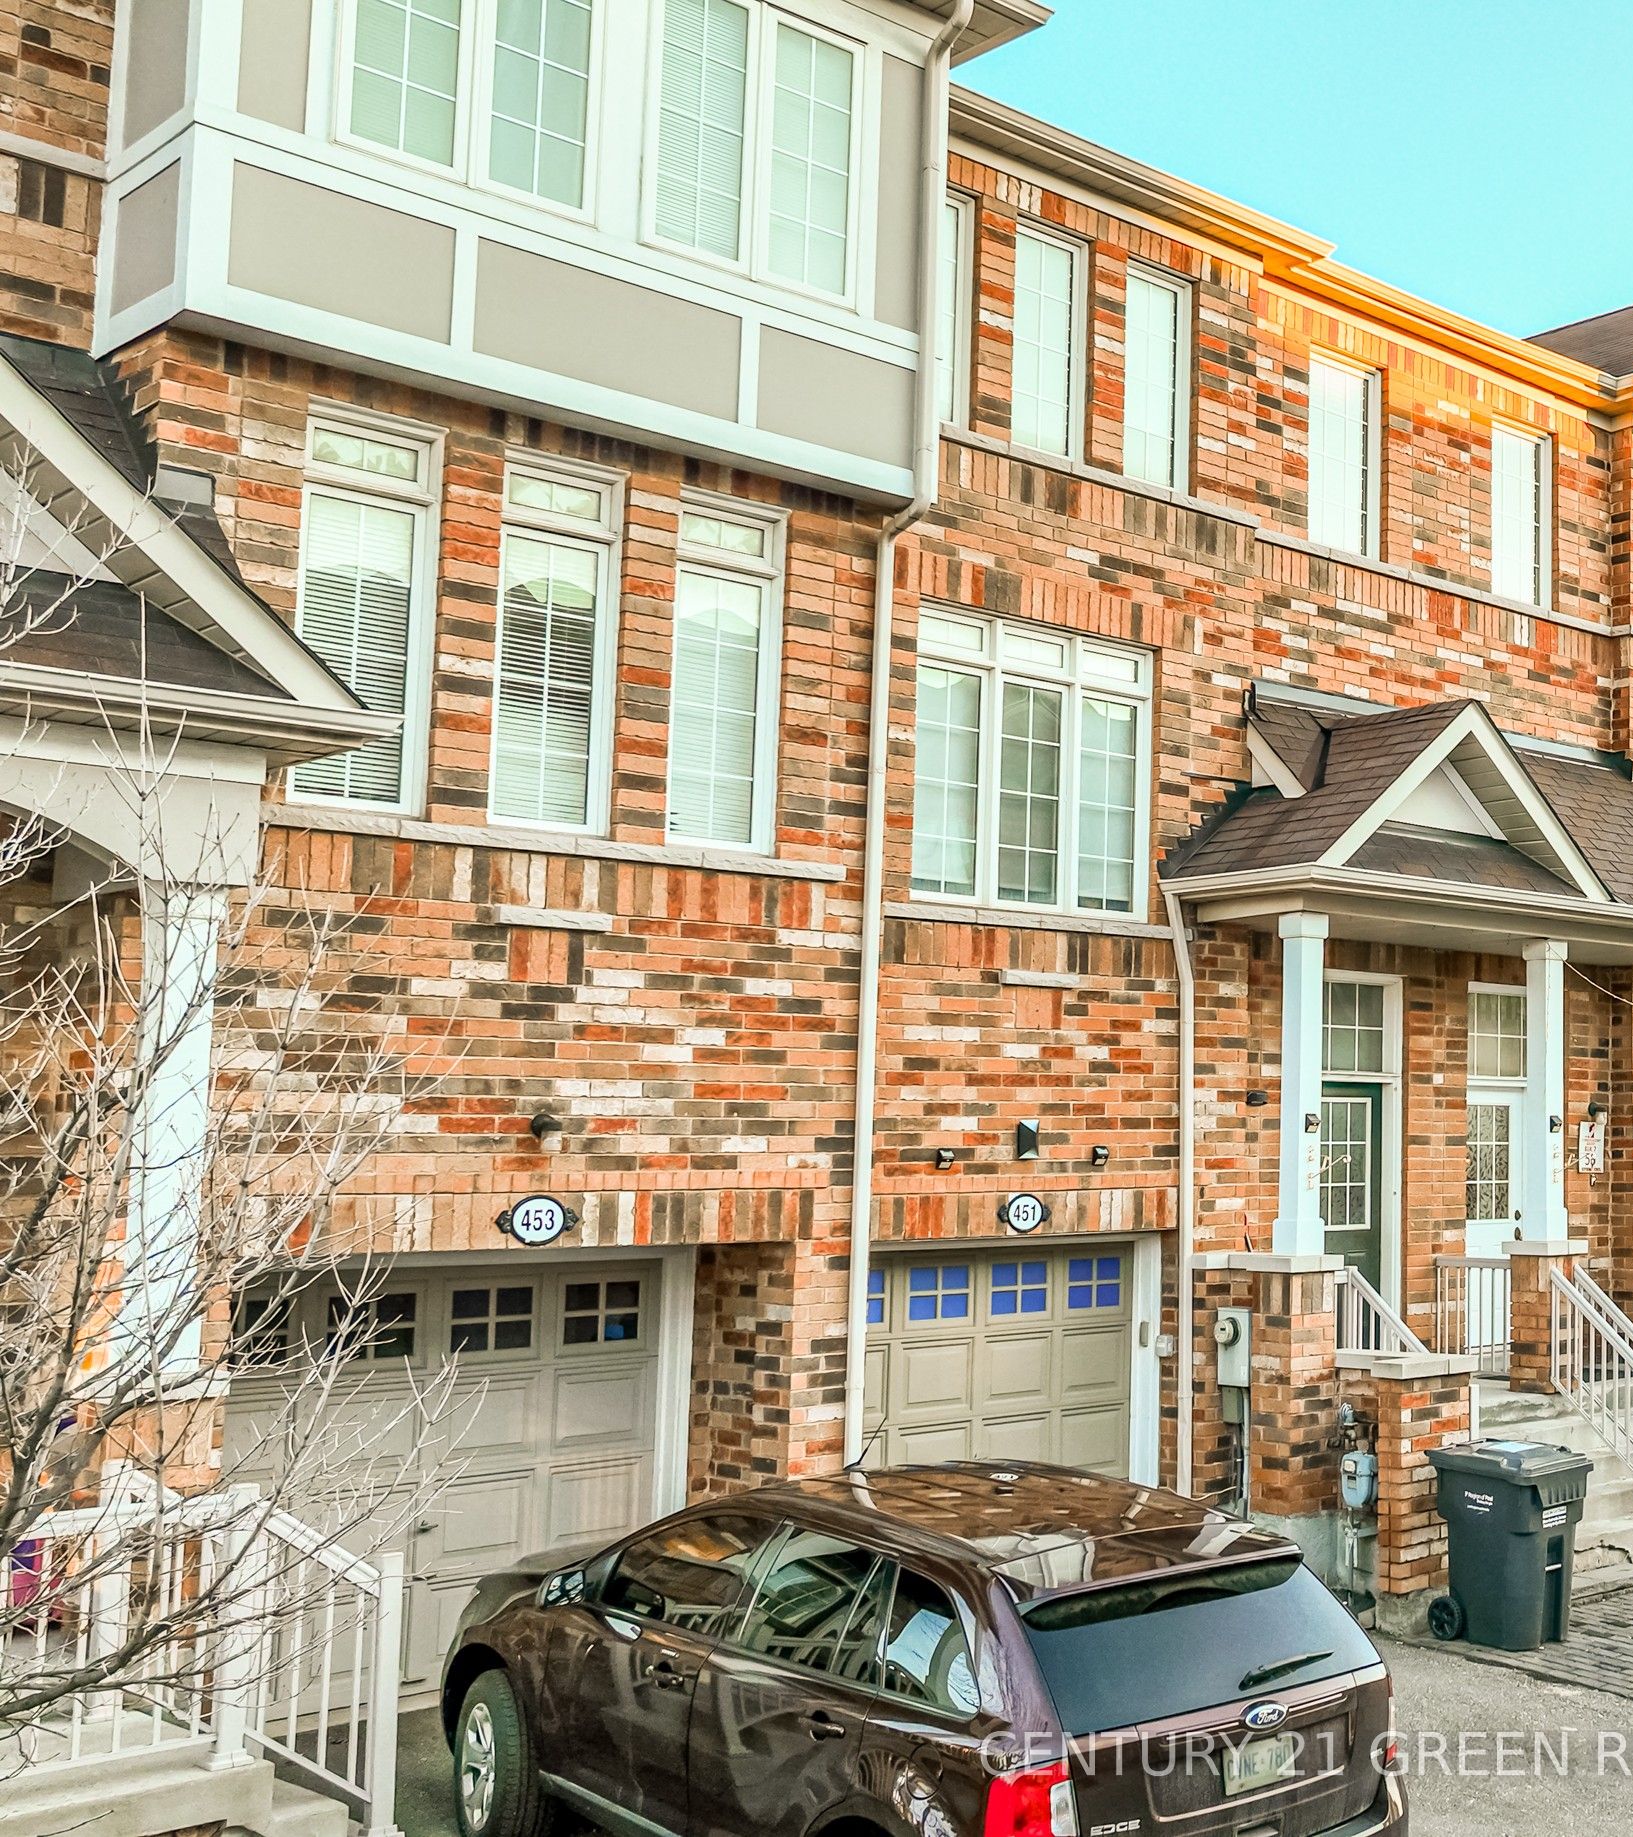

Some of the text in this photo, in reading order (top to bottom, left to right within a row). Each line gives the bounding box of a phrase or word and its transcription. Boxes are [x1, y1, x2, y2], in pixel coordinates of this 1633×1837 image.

[521, 1209, 555, 1231] 453
[1013, 1204, 1036, 1221] 451
[1256, 1708, 1279, 1725] Ford
[1090, 1819, 1141, 1836] EDGE
